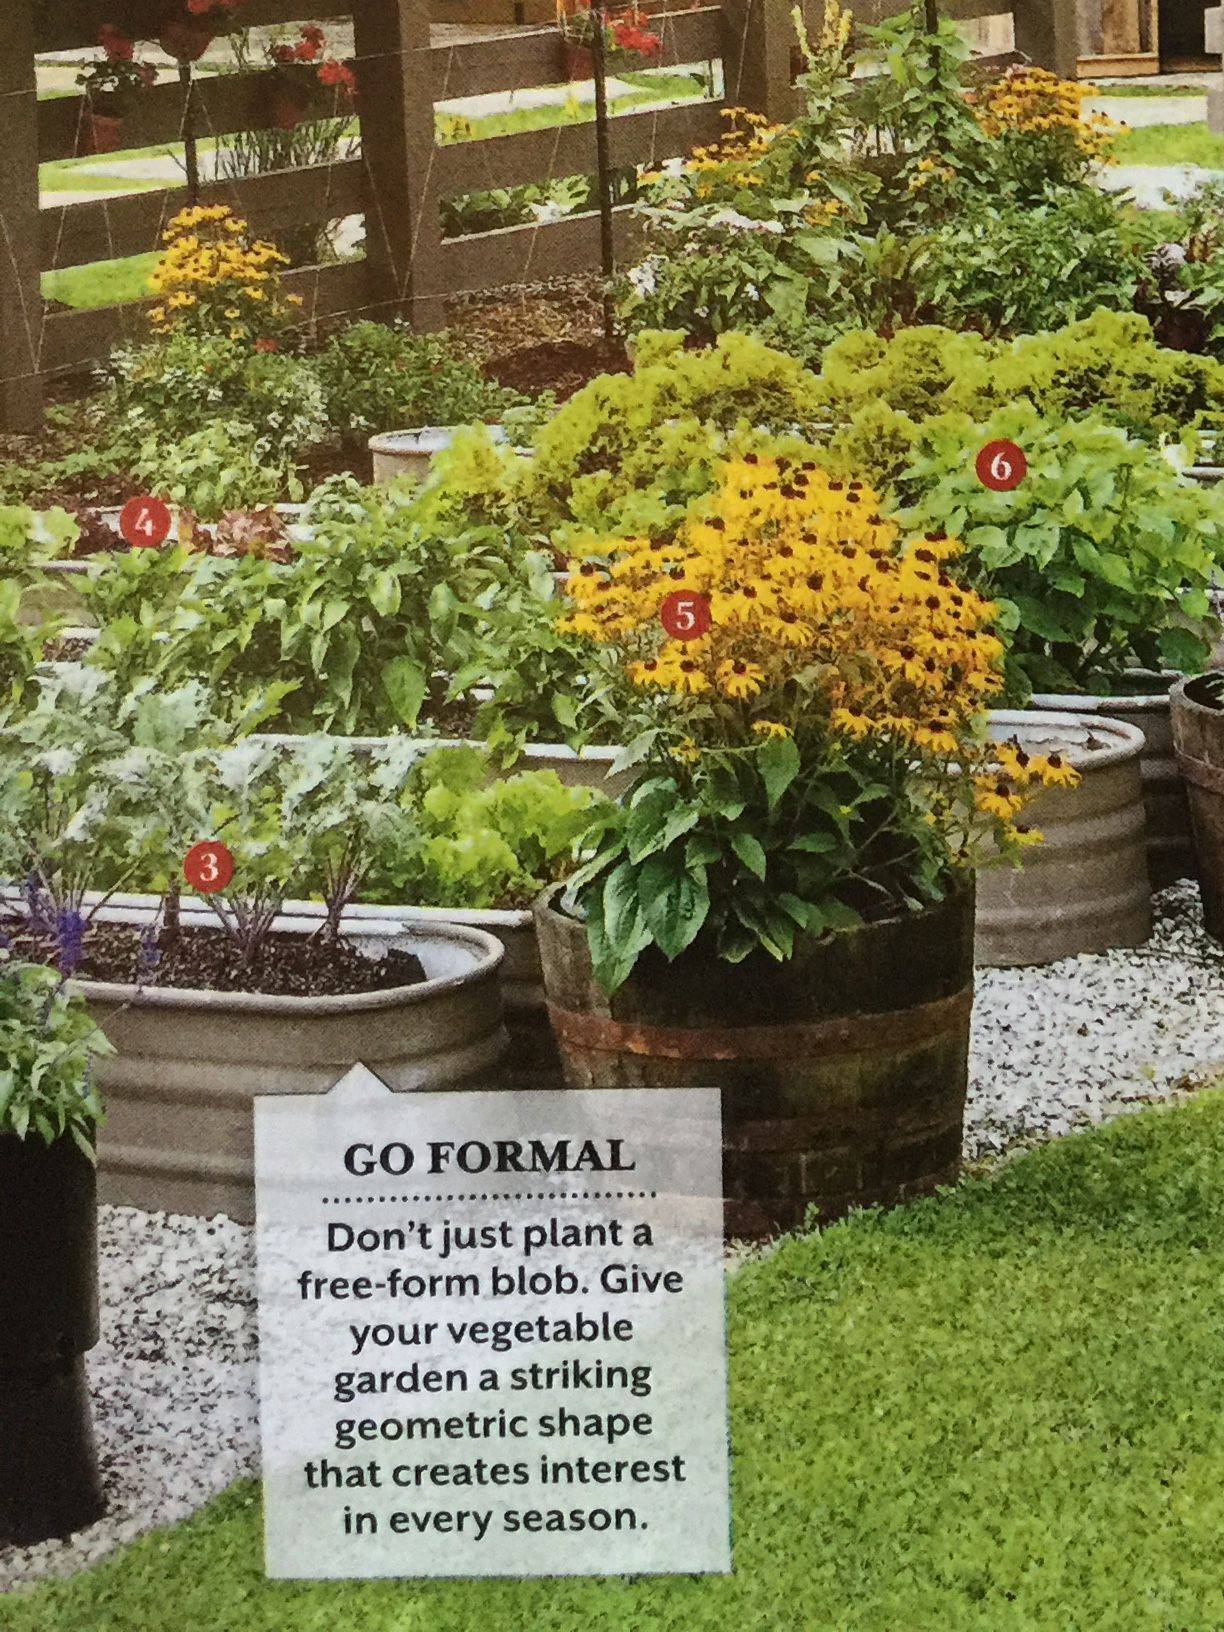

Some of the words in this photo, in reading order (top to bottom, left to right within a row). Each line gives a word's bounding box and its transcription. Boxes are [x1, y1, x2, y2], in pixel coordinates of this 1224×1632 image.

[991, 451, 1012, 481] 6
[135, 508, 157, 537] 4
[676, 601, 696, 631] 5
[200, 853, 219, 882] 3
[343, 1141, 415, 1177] GO
[426, 1138, 637, 1174] FORMAL
[438, 1219, 514, 1259] just
[523, 1217, 623, 1257] plant
[632, 1222, 654, 1247] a
[296, 1268, 480, 1300] free-form
[491, 1264, 589, 1297] blob.
[600, 1263, 684, 1294] Give
[349, 1322, 439, 1356] your
[446, 1311, 634, 1353] vegetable
[333, 1361, 468, 1403] garden
[478, 1368, 501, 1392] a
[510, 1358, 653, 1398] striking
[334, 1408, 528, 1450] geometric
[538, 1406, 653, 1445] shape
[303, 1458, 383, 1490] that
[391, 1458, 530, 1488] creates
[540, 1454, 687, 1484] interest
[343, 1505, 378, 1535] in
[389, 1510, 494, 1542] every
[503, 1507, 648, 1533] season.
